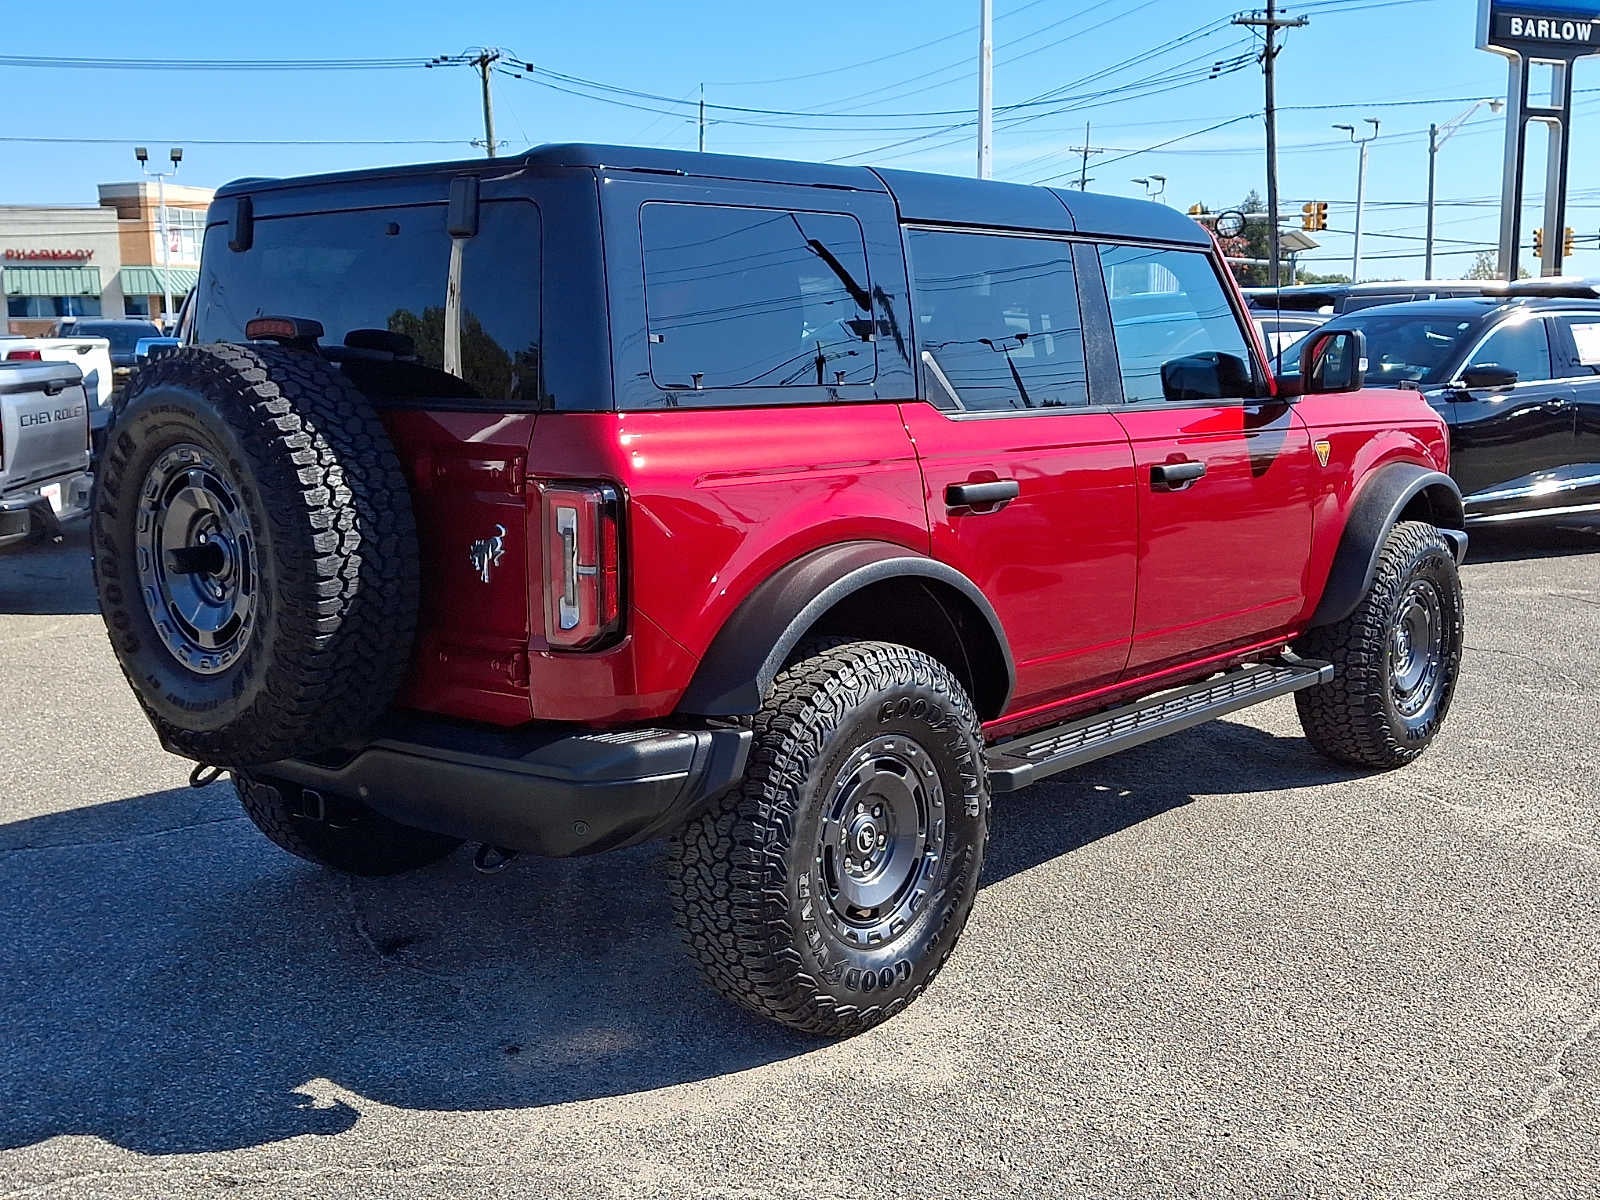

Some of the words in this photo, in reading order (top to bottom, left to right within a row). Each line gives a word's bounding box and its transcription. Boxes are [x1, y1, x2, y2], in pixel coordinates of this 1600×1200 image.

[1510, 17, 1592, 41] BARLOW
[5, 249, 94, 261] PHARMACY
[20, 406, 84, 427] CHEVROLET
[797, 872, 913, 992] GOODYEAR
